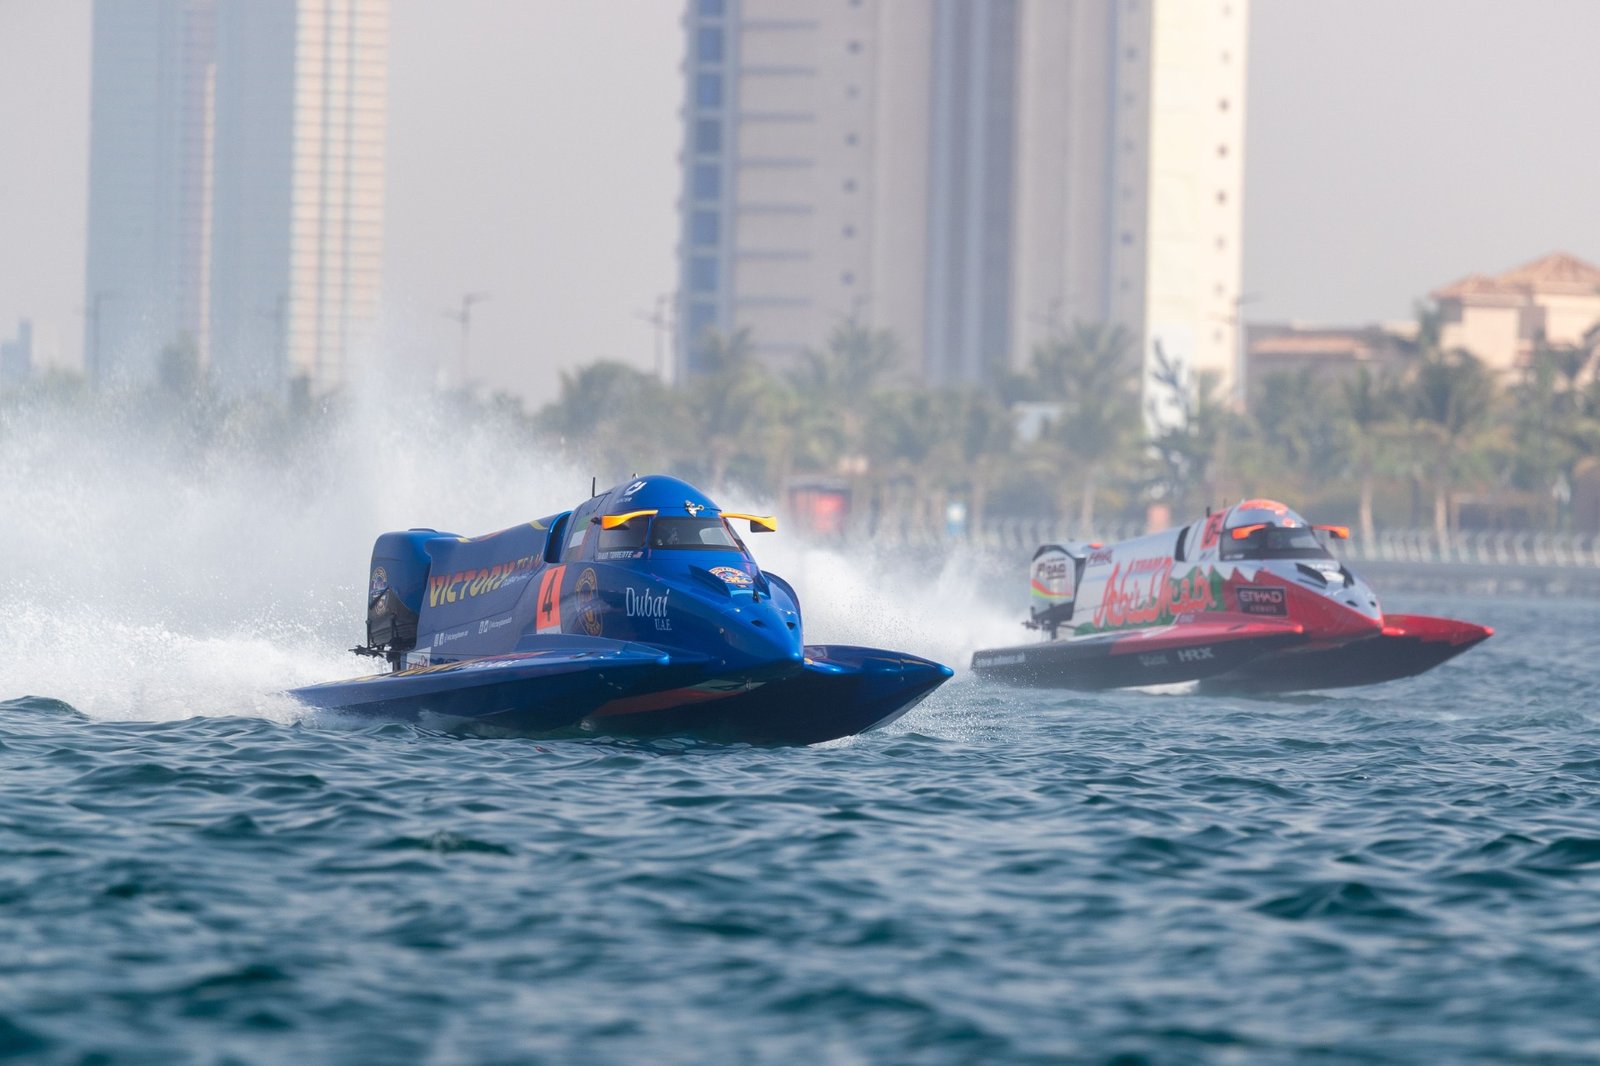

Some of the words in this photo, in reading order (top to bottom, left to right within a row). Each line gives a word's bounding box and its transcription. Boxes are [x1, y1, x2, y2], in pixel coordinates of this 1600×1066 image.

[429, 560, 515, 608] VICTORY
[541, 569, 558, 622] 4
[625, 587, 670, 617] Dubai
[1240, 590, 1282, 603] ETIHAD
